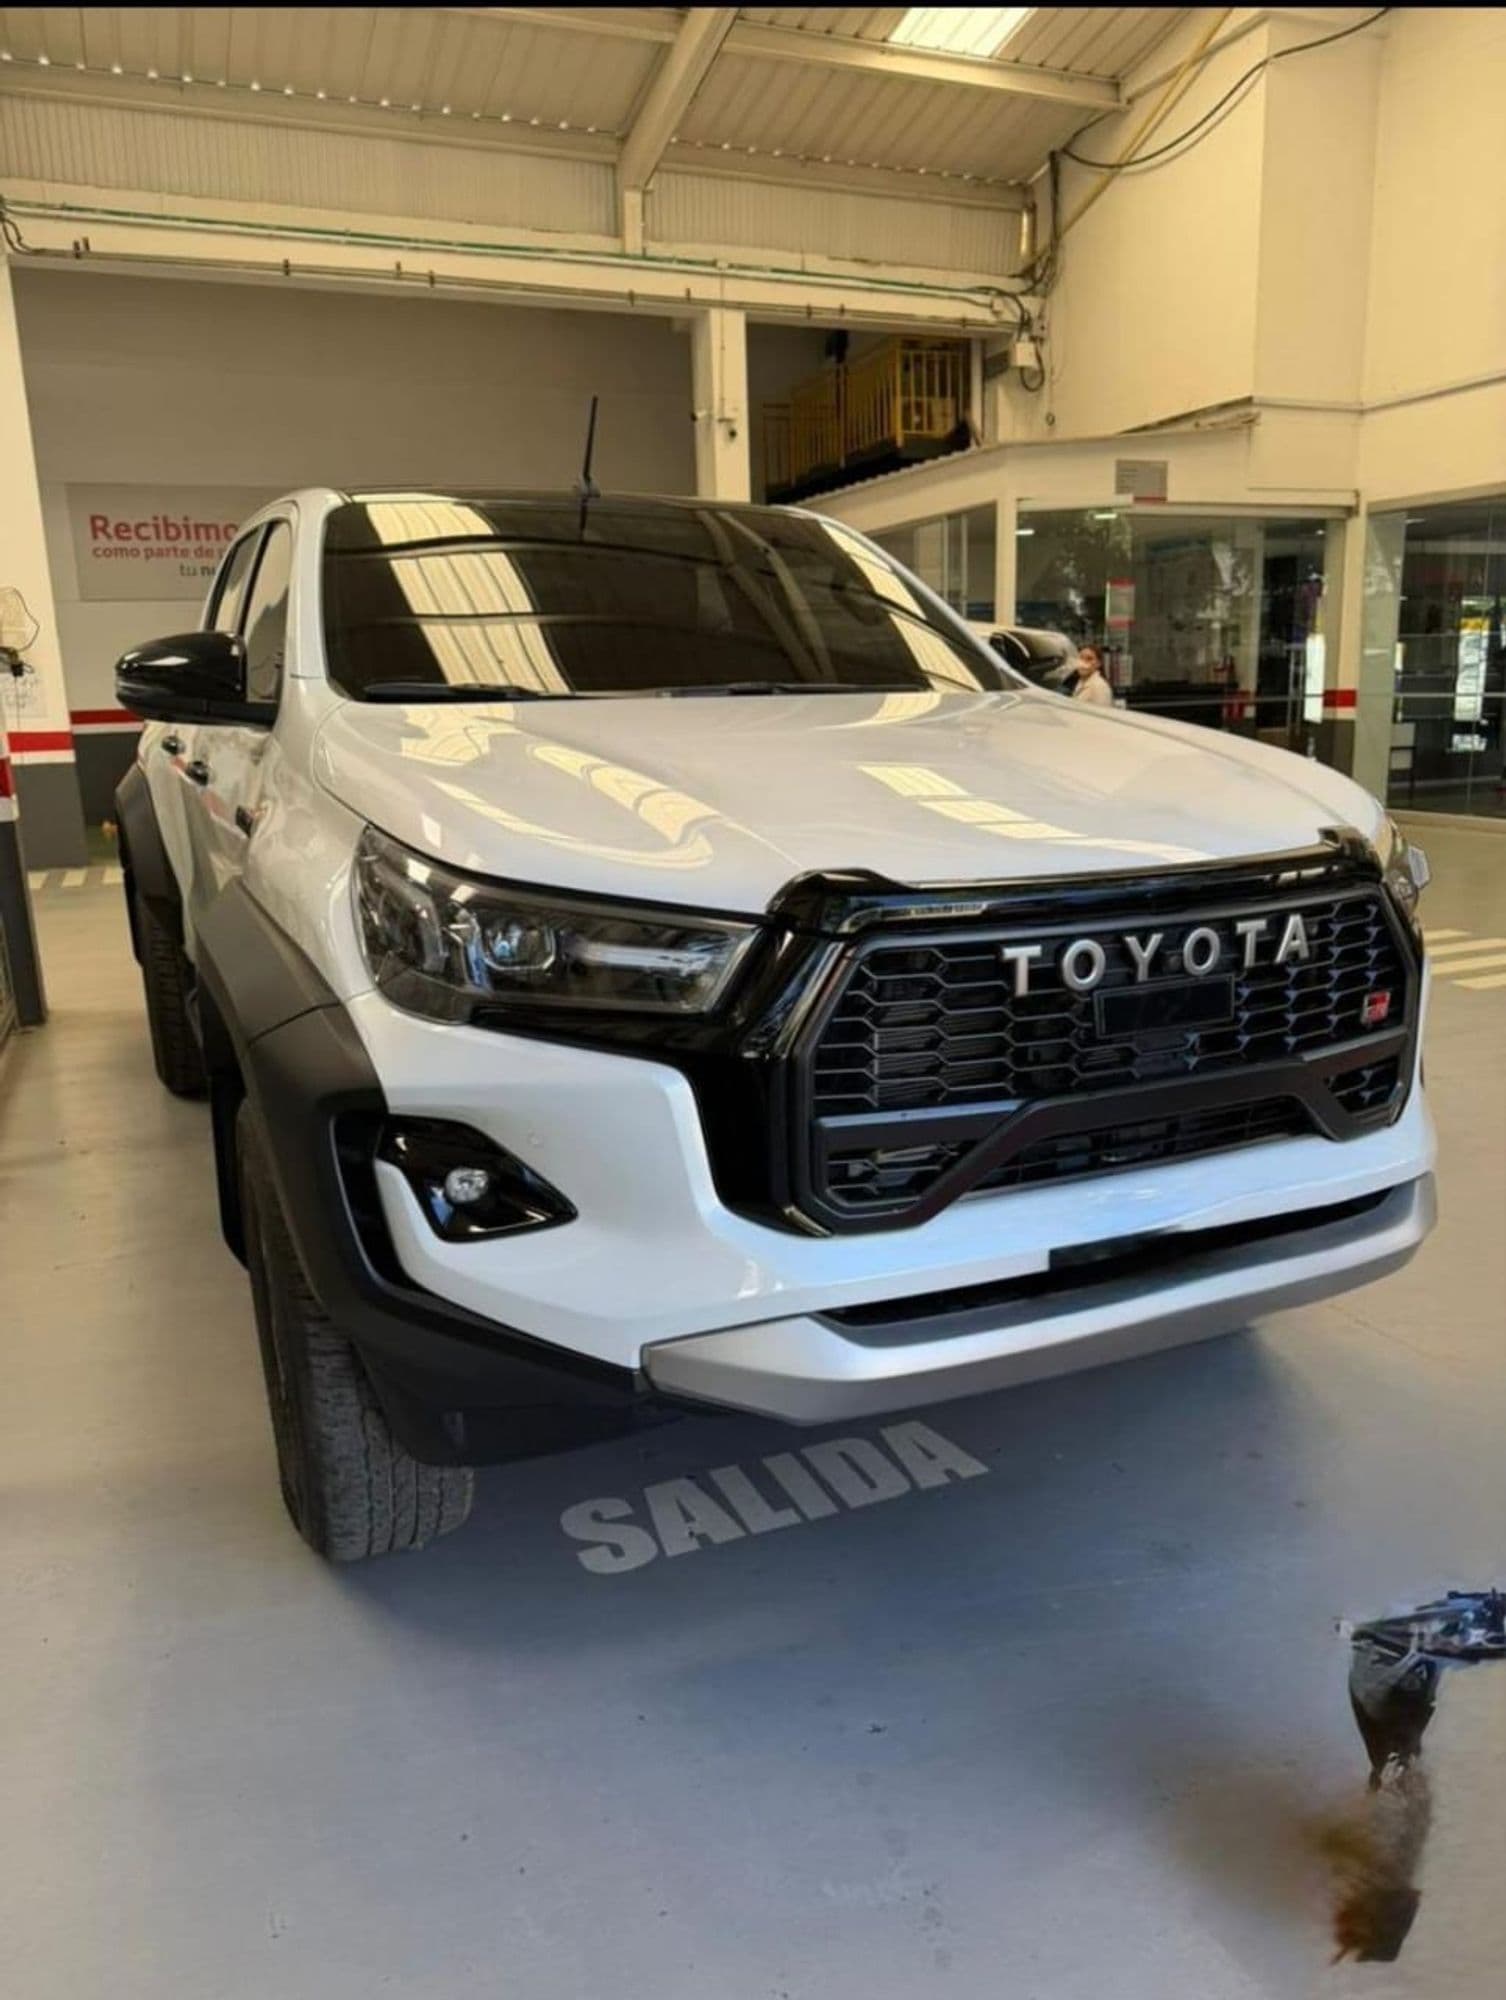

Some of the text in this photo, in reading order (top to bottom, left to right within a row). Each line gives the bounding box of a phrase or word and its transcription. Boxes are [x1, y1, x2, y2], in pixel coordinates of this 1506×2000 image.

[92, 547, 140, 558] como
[144, 547, 189, 561] parte
[194, 546, 214, 558] de
[179, 564, 197, 576] tu
[1003, 914, 1310, 997] TOYOTA
[560, 1420, 990, 1574] SALIDA
